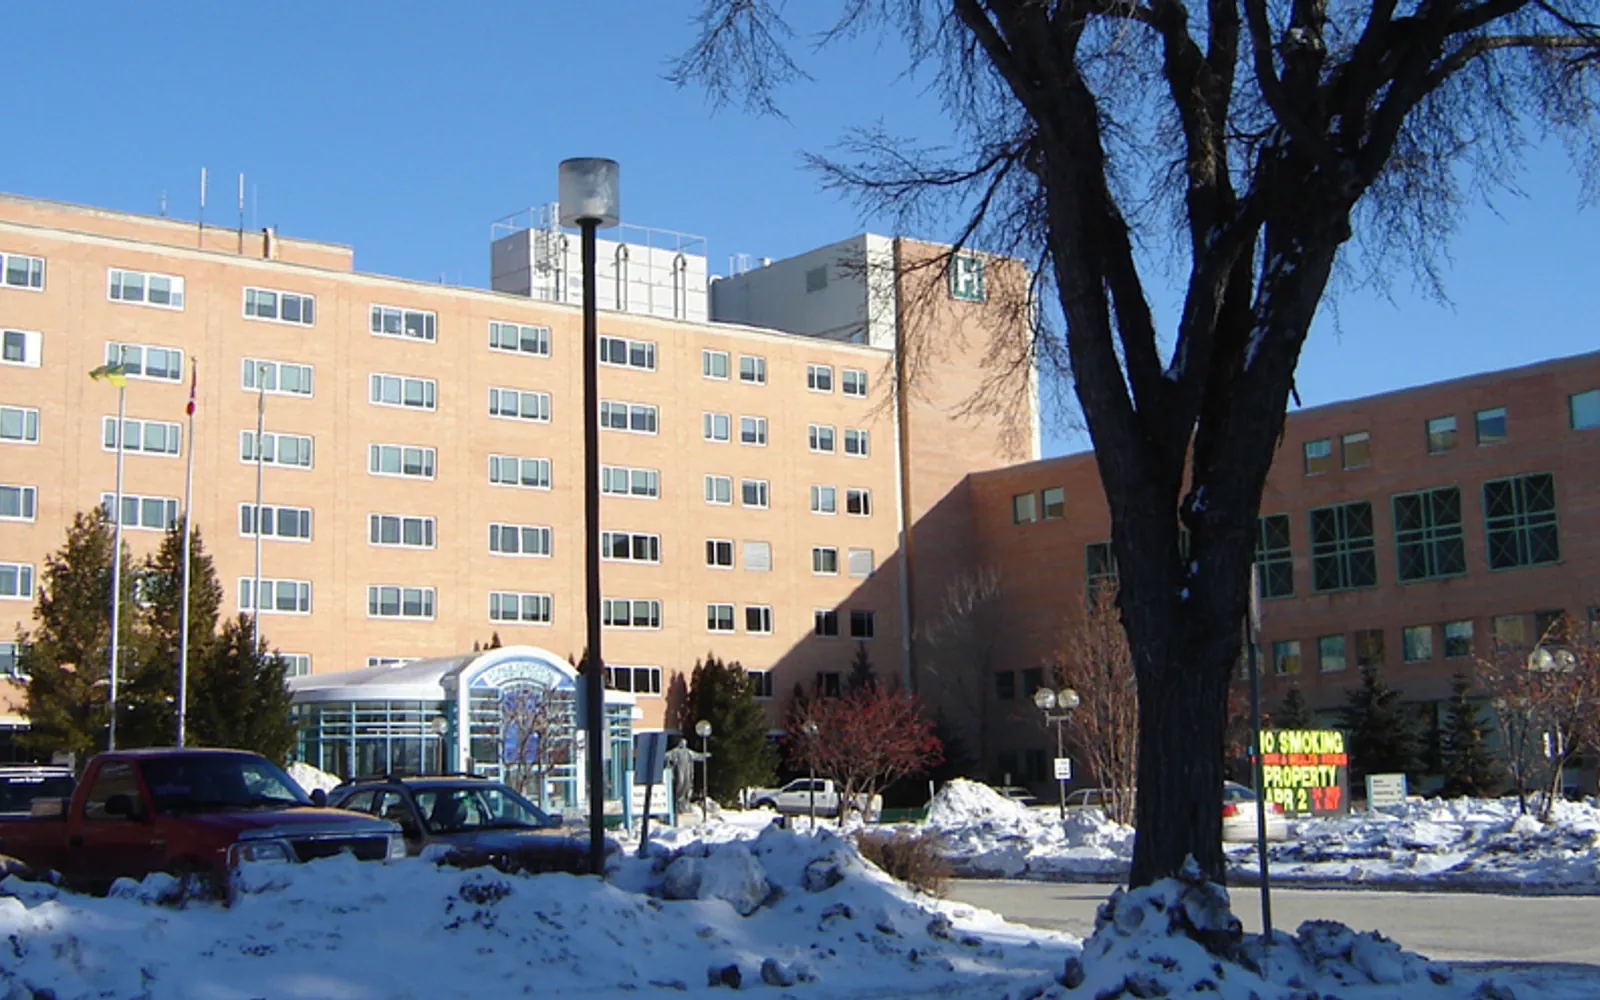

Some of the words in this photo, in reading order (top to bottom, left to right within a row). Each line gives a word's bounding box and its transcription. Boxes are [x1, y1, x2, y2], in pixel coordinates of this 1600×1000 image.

[957, 258, 979, 296] H
[1279, 730, 1344, 754] SMOKING
[1263, 764, 1336, 788] PROPERTY
